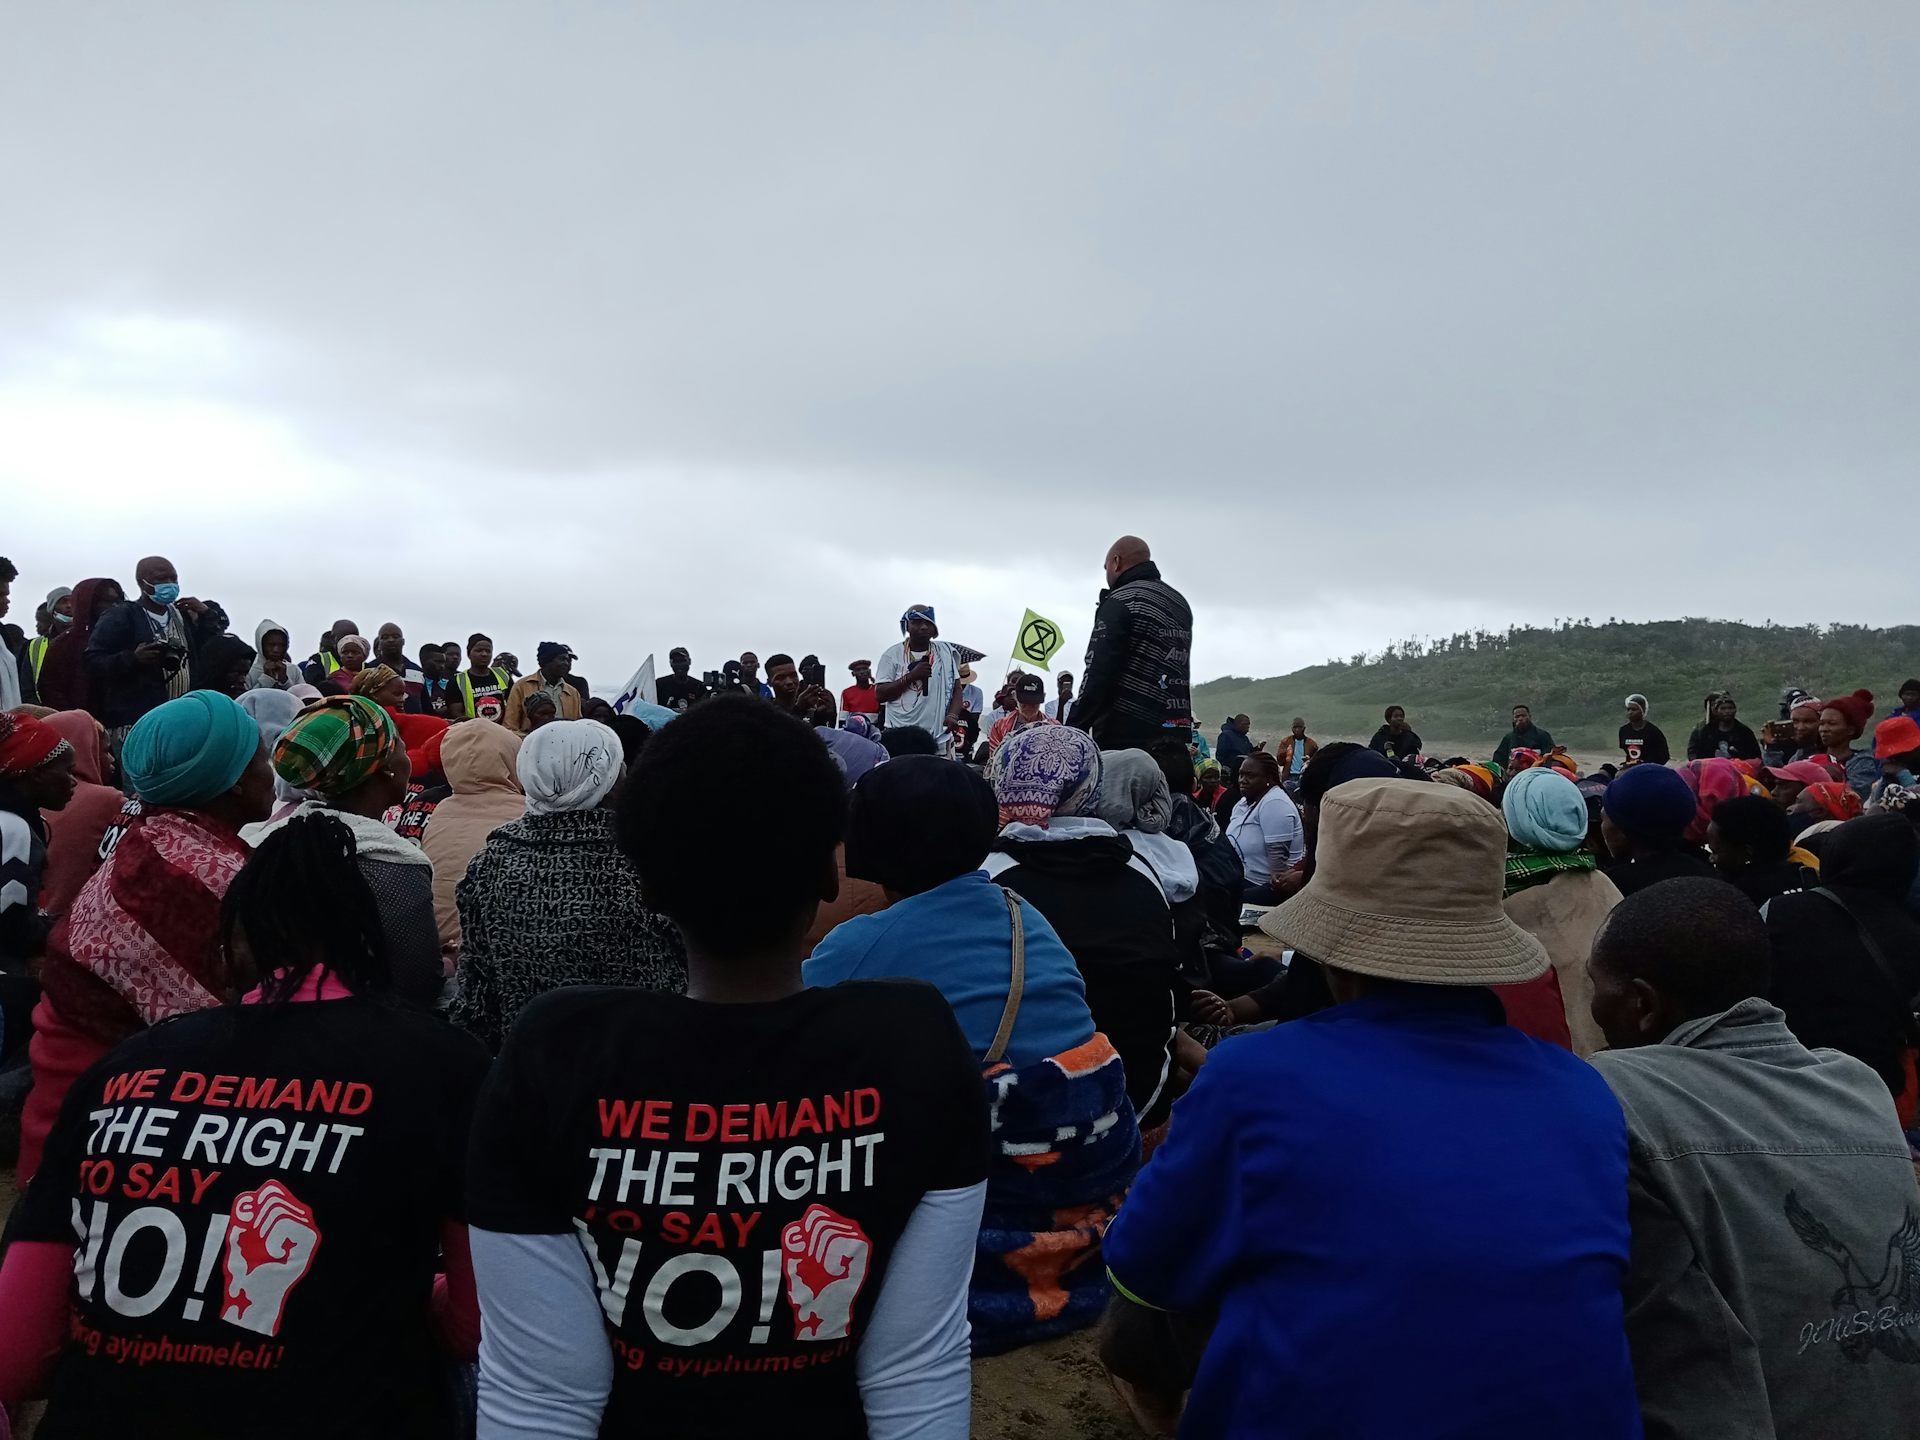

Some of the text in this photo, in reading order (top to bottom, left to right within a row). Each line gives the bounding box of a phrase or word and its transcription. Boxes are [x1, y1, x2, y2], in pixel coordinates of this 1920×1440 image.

[102, 1068, 373, 1115] WE DEMAND
[598, 1087, 881, 1142] WE DEMAND
[86, 1105, 364, 1174] THE RIGHT
[79, 1160, 221, 1204] TO SAY
[588, 1132, 885, 1206] THE RIGHT
[659, 1211, 762, 1249] SAY
